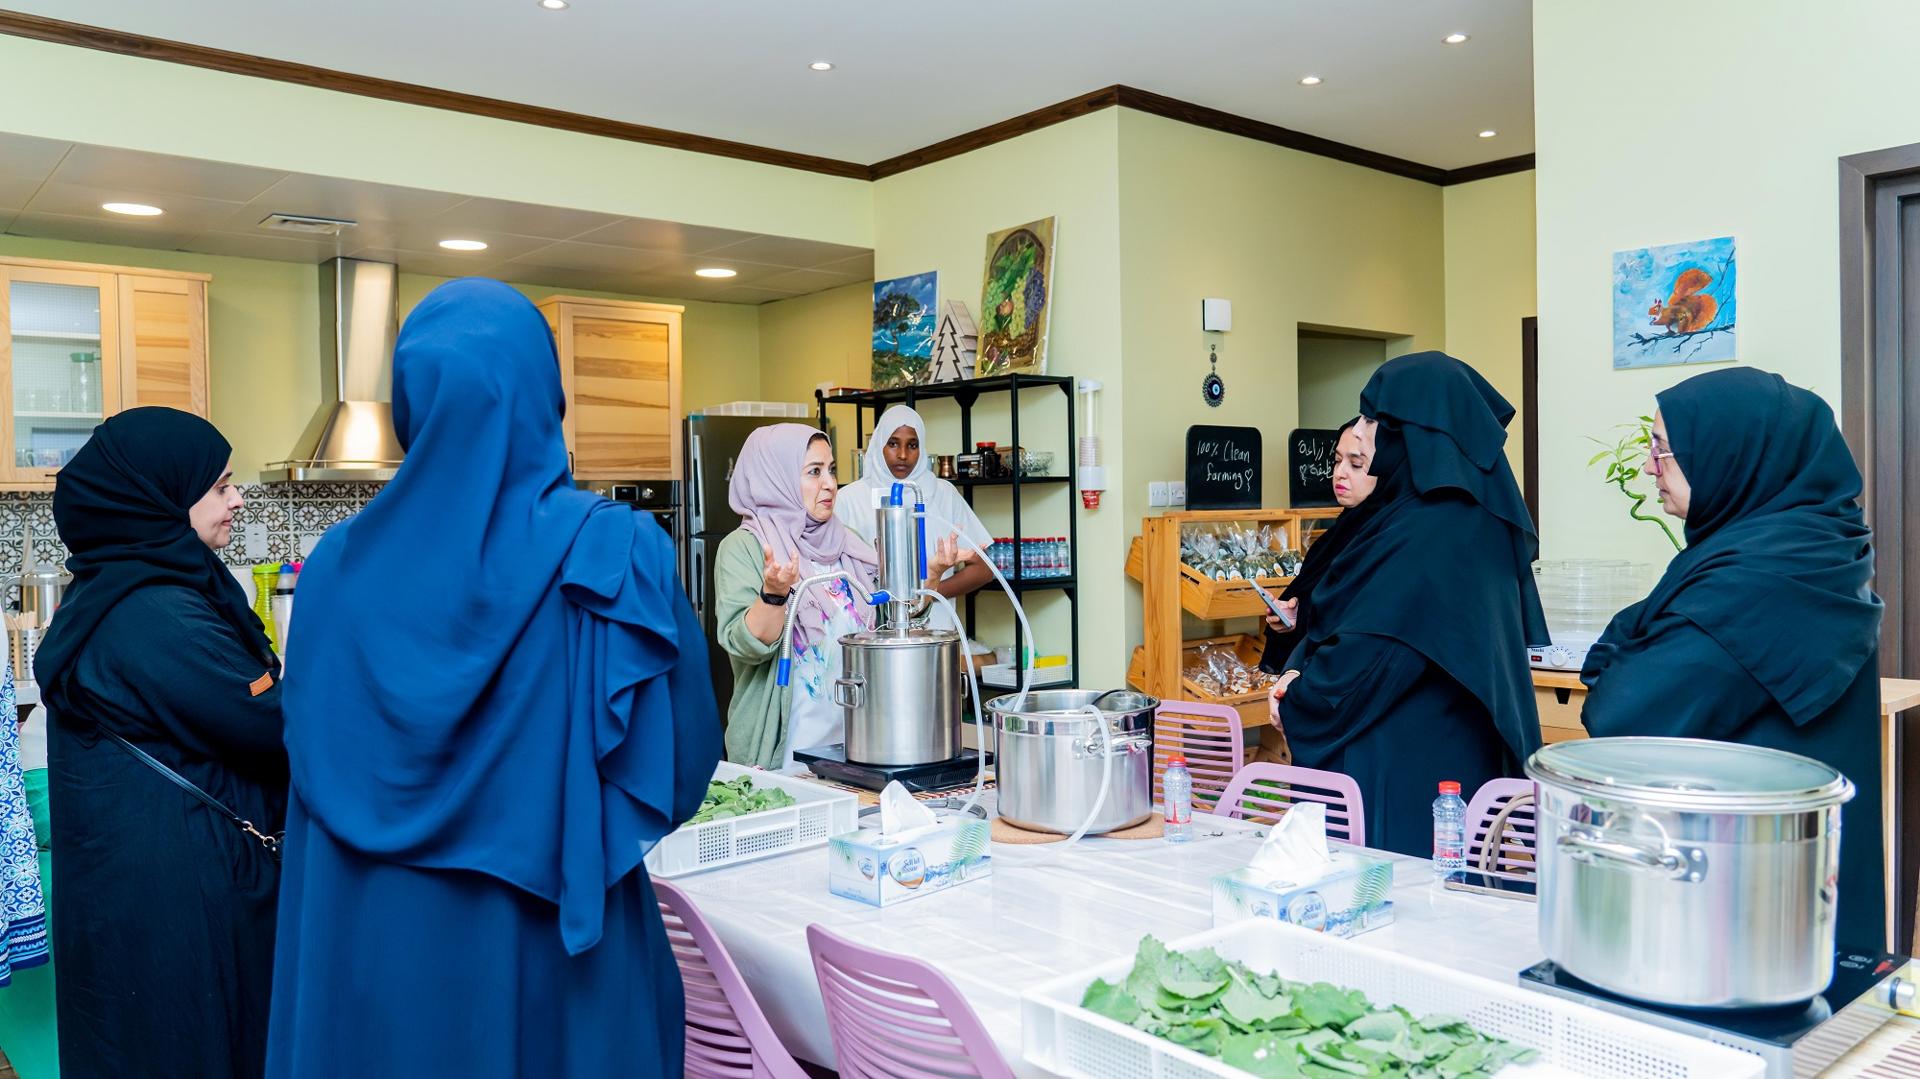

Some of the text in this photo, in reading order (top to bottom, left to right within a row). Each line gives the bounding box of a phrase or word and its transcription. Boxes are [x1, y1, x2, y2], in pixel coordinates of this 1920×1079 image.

[1197, 440, 1250, 463] 100% Clean
[1206, 462, 1243, 490] farming
